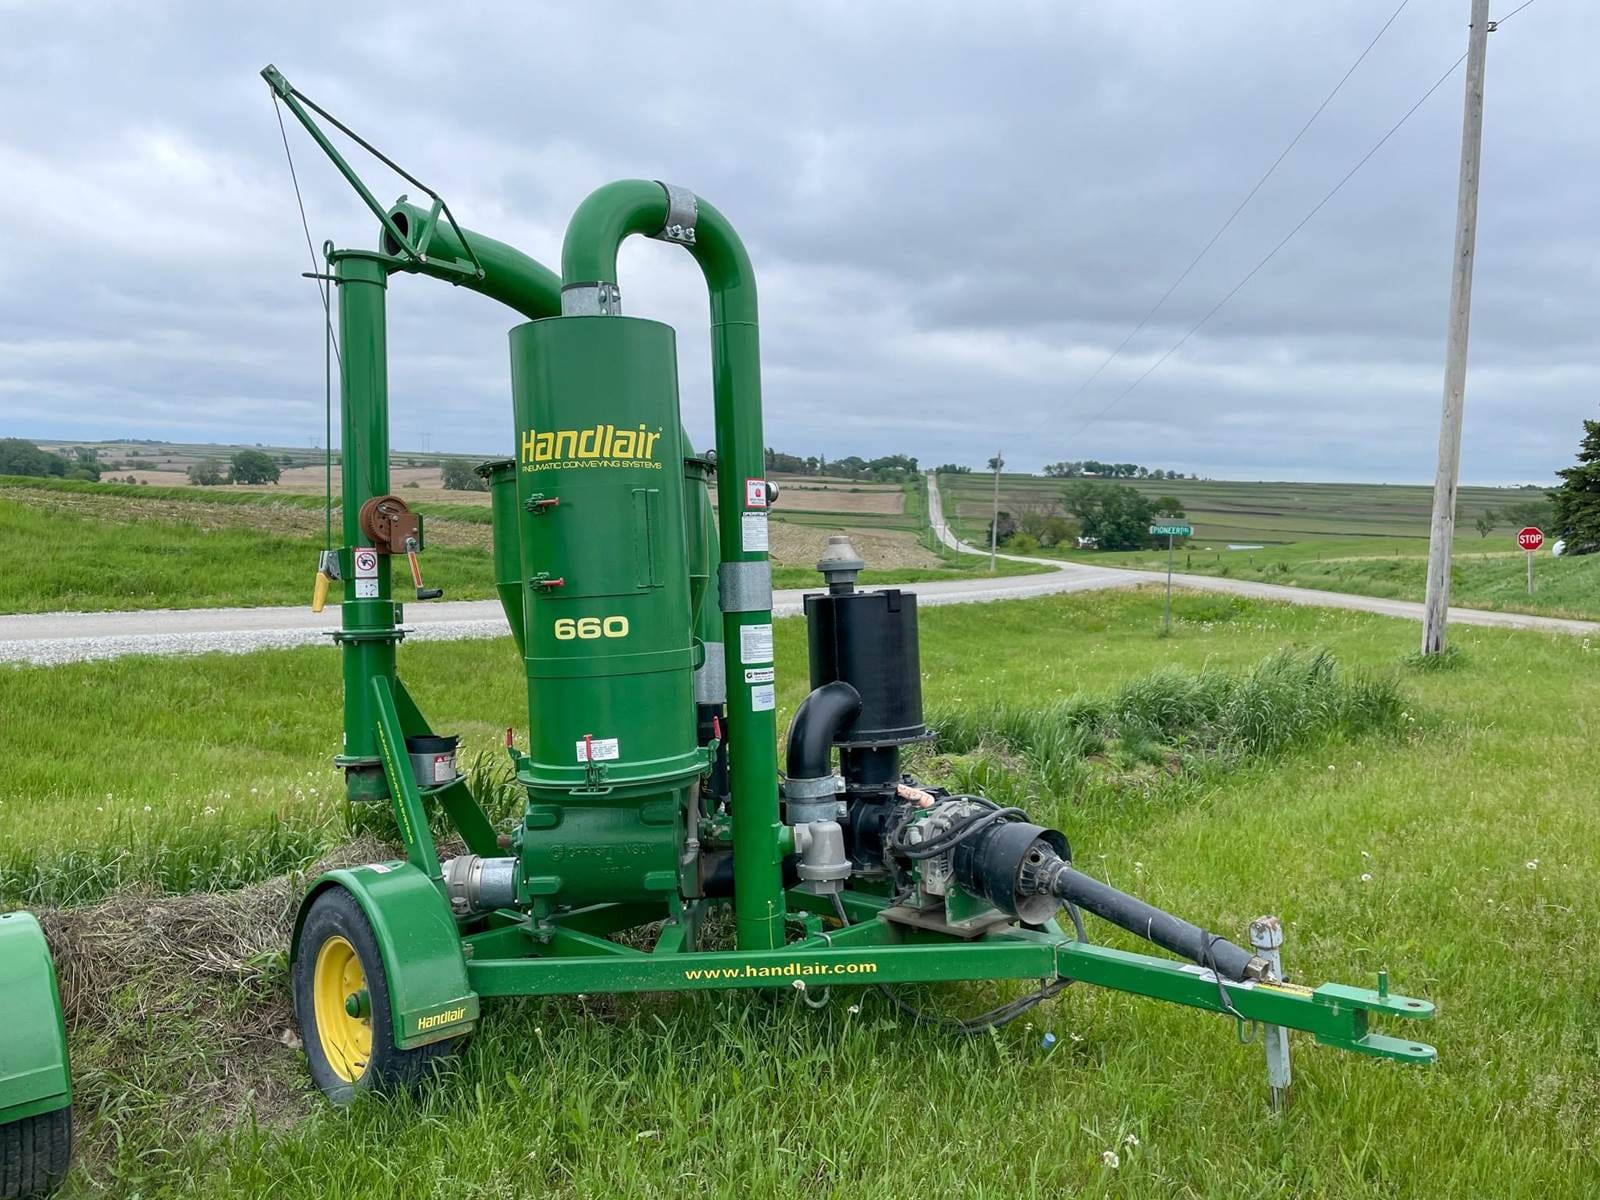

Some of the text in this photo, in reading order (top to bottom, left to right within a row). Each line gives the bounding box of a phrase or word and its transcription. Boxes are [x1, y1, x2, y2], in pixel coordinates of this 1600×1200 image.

[521, 423, 661, 464] Handlair
[522, 460, 663, 473] PNEUMATIC CONVEYING SYSTEMS
[1153, 526, 1180, 535] PIONEER
[1519, 534, 1542, 544] STOP
[554, 616, 629, 640] 660
[685, 962, 877, 980] www.handlair.com
[417, 1007, 466, 1030] Handlair
